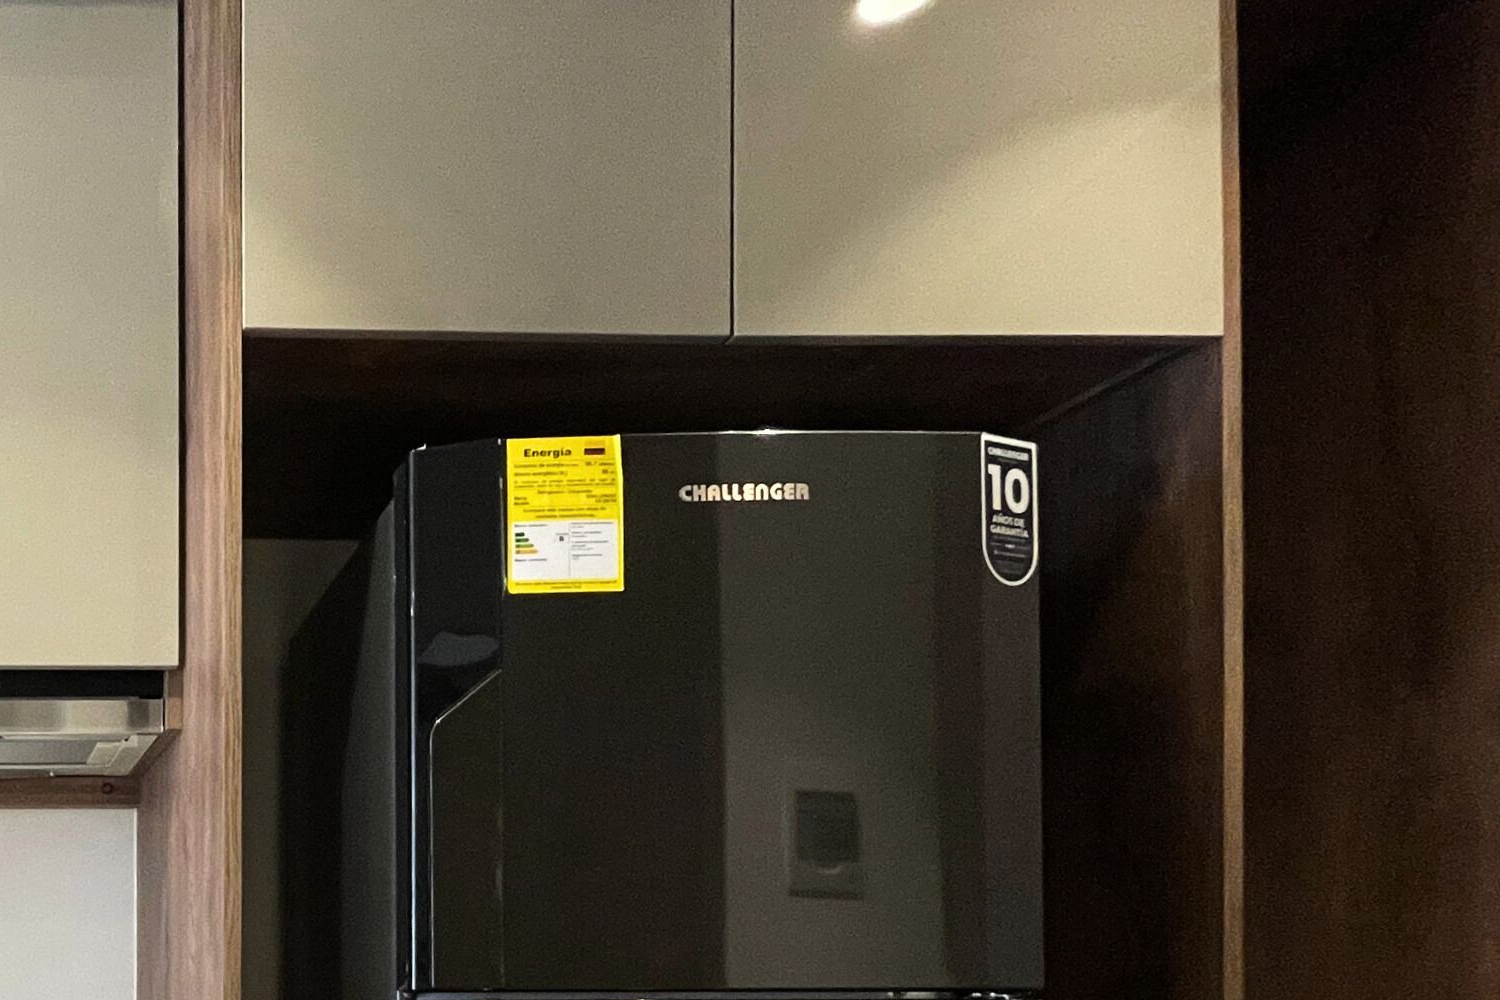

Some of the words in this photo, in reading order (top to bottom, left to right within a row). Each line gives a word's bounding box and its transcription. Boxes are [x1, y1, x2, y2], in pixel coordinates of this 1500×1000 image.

[523, 446, 572, 459] Energía
[678, 482, 810, 502] CHALLENGER
[987, 463, 1030, 514] 10
[1014, 517, 1025, 528] DE
